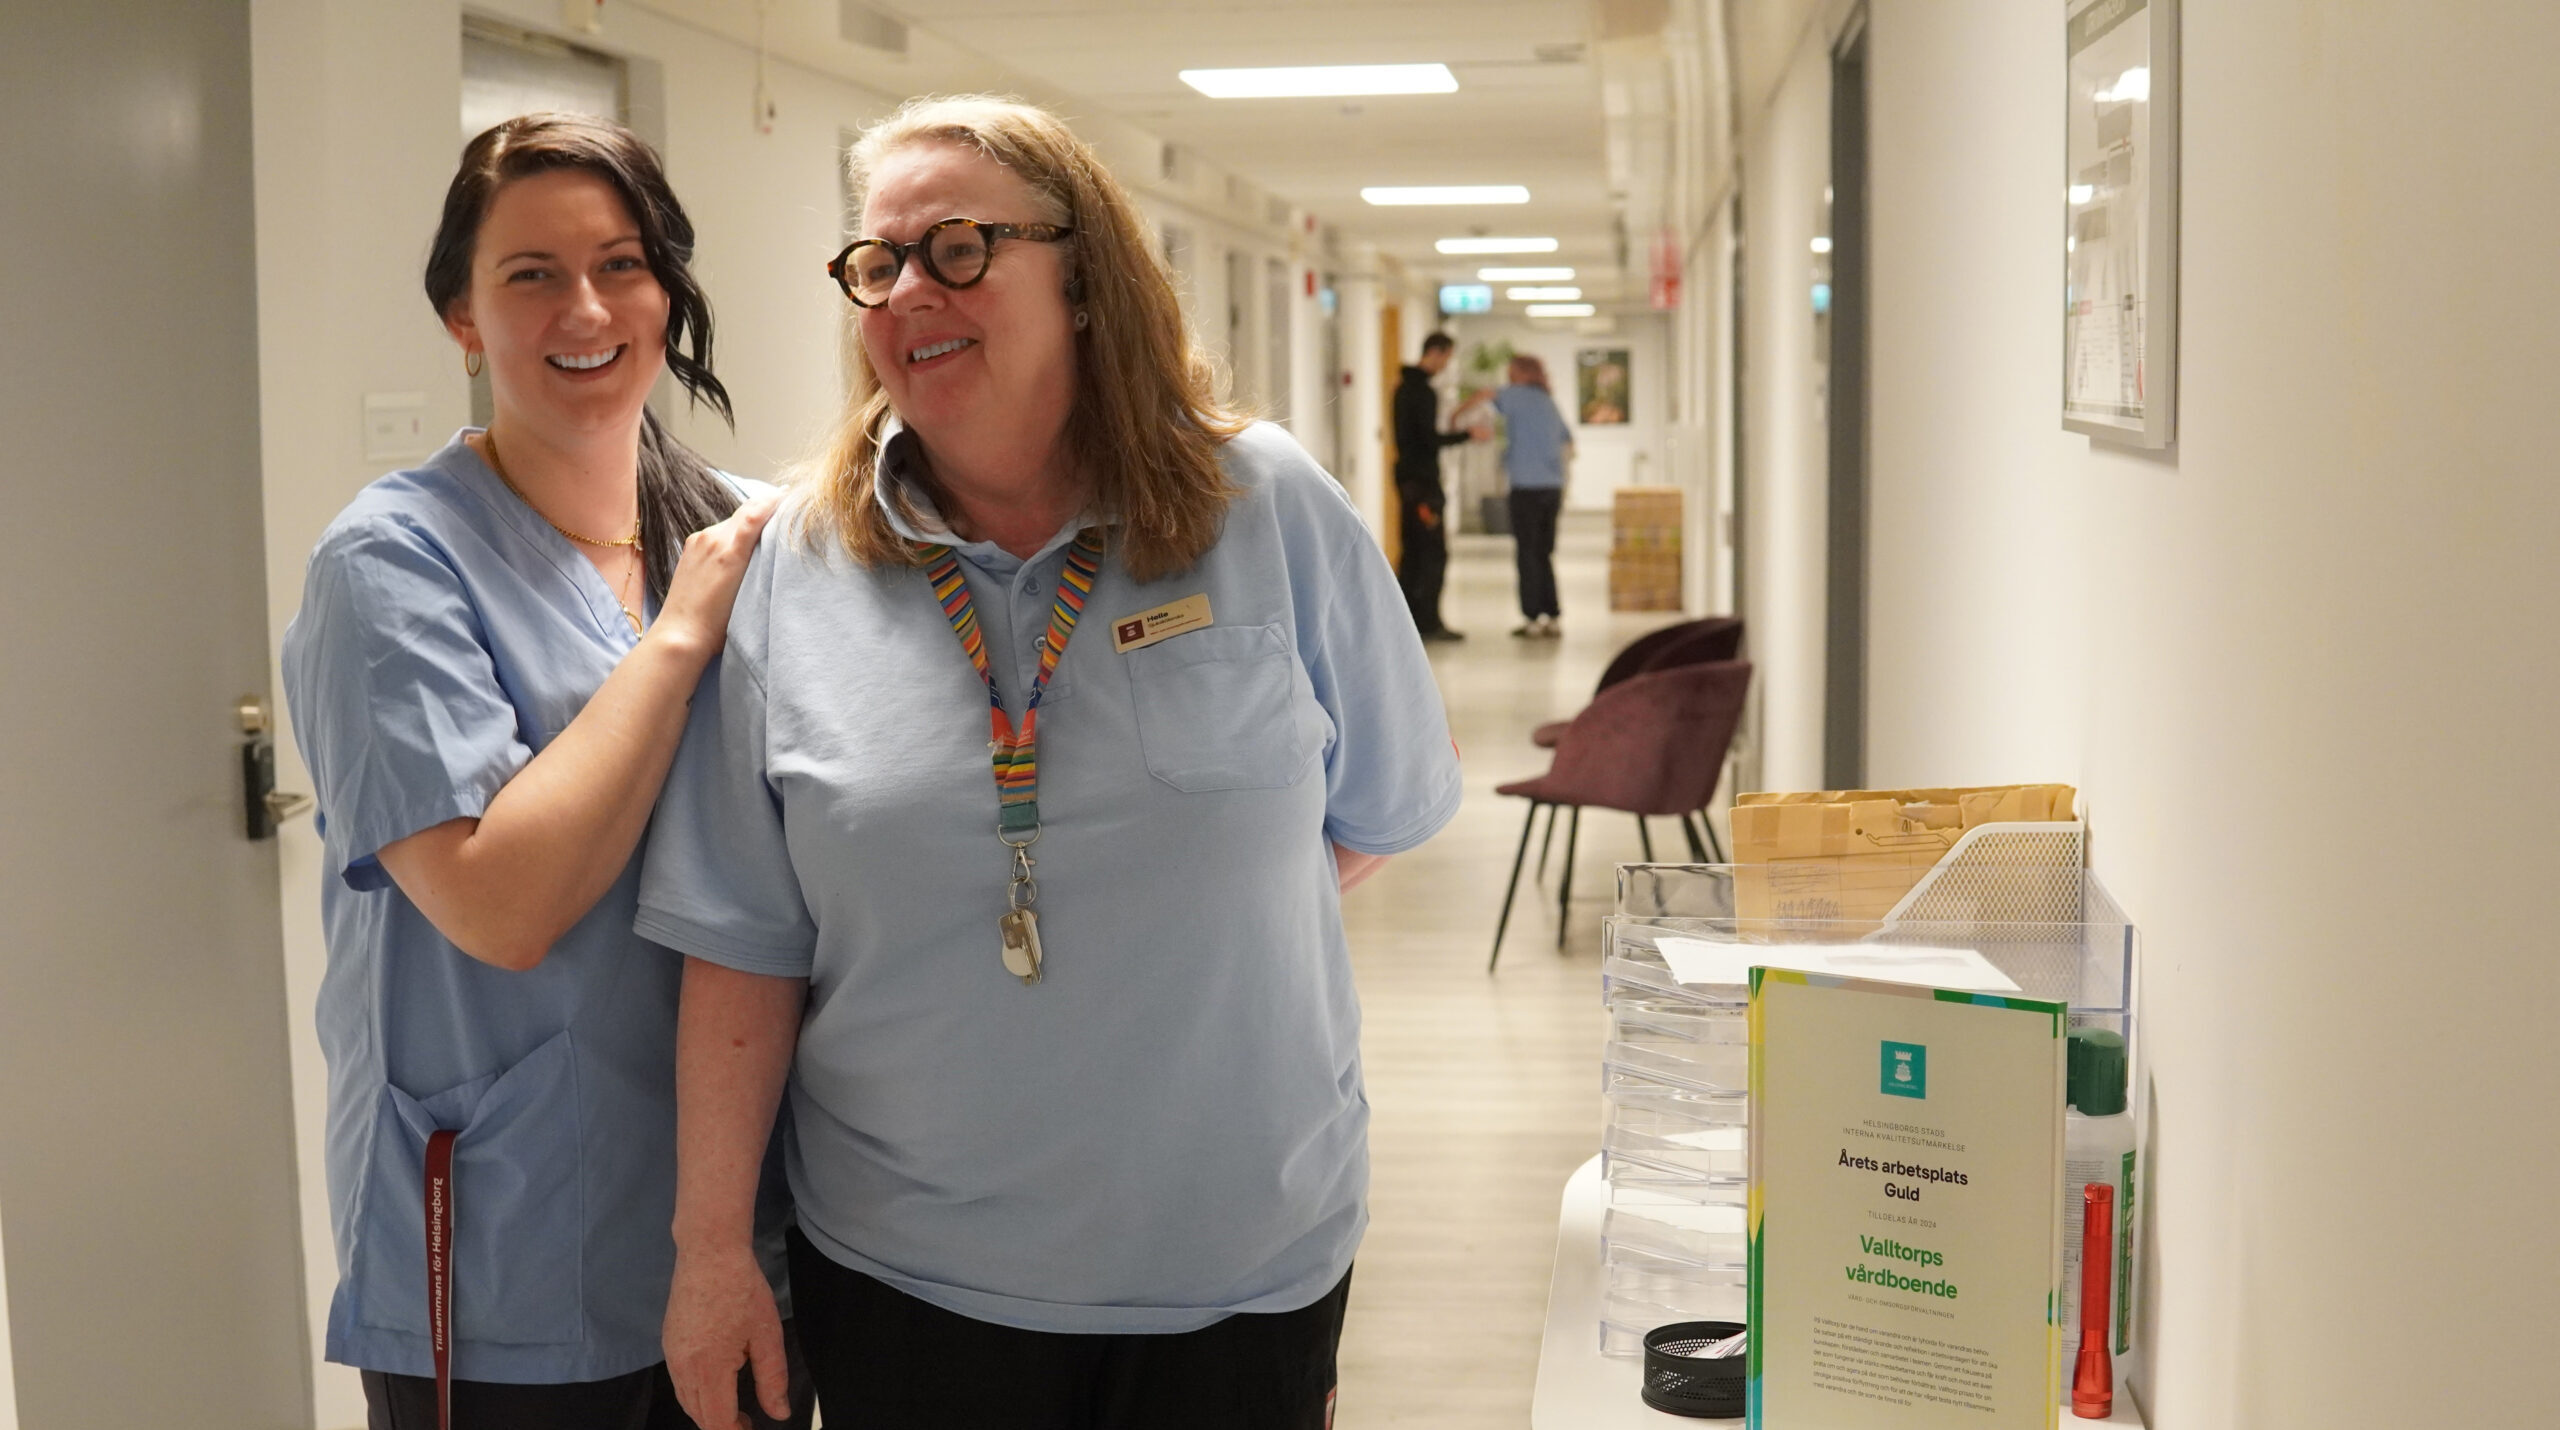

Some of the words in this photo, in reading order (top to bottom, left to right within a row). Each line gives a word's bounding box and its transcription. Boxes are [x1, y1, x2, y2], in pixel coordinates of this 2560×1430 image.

[1842, 1127, 1874, 1138] INTERNA
[1862, 1118, 1918, 1133] HELSINGBORGS
[1920, 1127, 1945, 1138] STADS
[1838, 1148, 1878, 1172] Årets
[1881, 1160, 1968, 1185] arbetsplats
[1884, 1182, 1920, 1201] Guld
[432, 1177, 444, 1253] Helsingborg
[1868, 1210, 1906, 1224] TILLDELAS
[1920, 1219, 1937, 1228] 2024
[1860, 1234, 1944, 1267] Valltorps
[433, 1255, 443, 1273] för
[1845, 1263, 1958, 1299] vårdboende
[434, 1274, 443, 1352] Tillsammans
